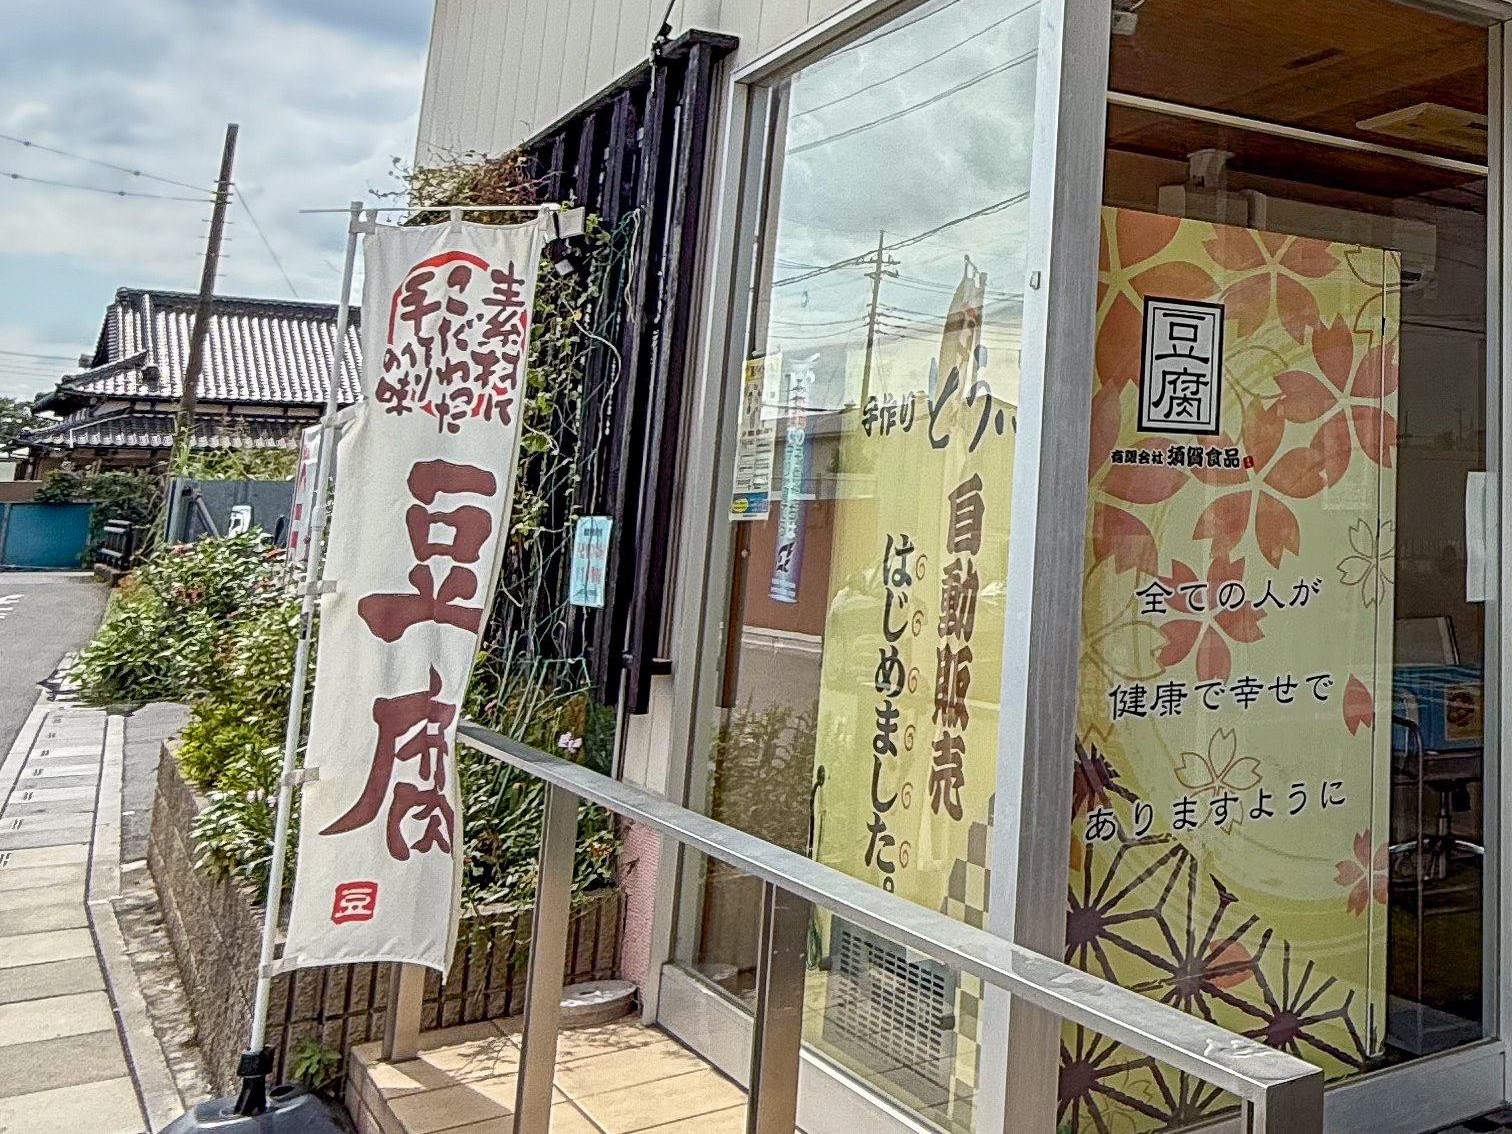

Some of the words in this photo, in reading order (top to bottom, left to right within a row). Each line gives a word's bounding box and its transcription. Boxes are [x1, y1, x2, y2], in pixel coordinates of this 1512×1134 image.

[436, 265, 472, 434] こだわった
[470, 259, 525, 426] 素材に
[1152, 311, 1210, 422] 豆腐
[861, 393, 915, 437] 手作り
[927, 345, 1017, 454] とう
[1111, 449, 1163, 465] 有限会社
[1167, 445, 1240, 468] 須賀食品
[929, 473, 985, 821] 自動販売
[1136, 577, 1322, 615] 全ての人が
[319, 459, 497, 861] 豆腐
[1108, 673, 1334, 720] 健康で幸せで
[1085, 780, 1347, 842] ありますように
[336, 887, 374, 918] 豆
